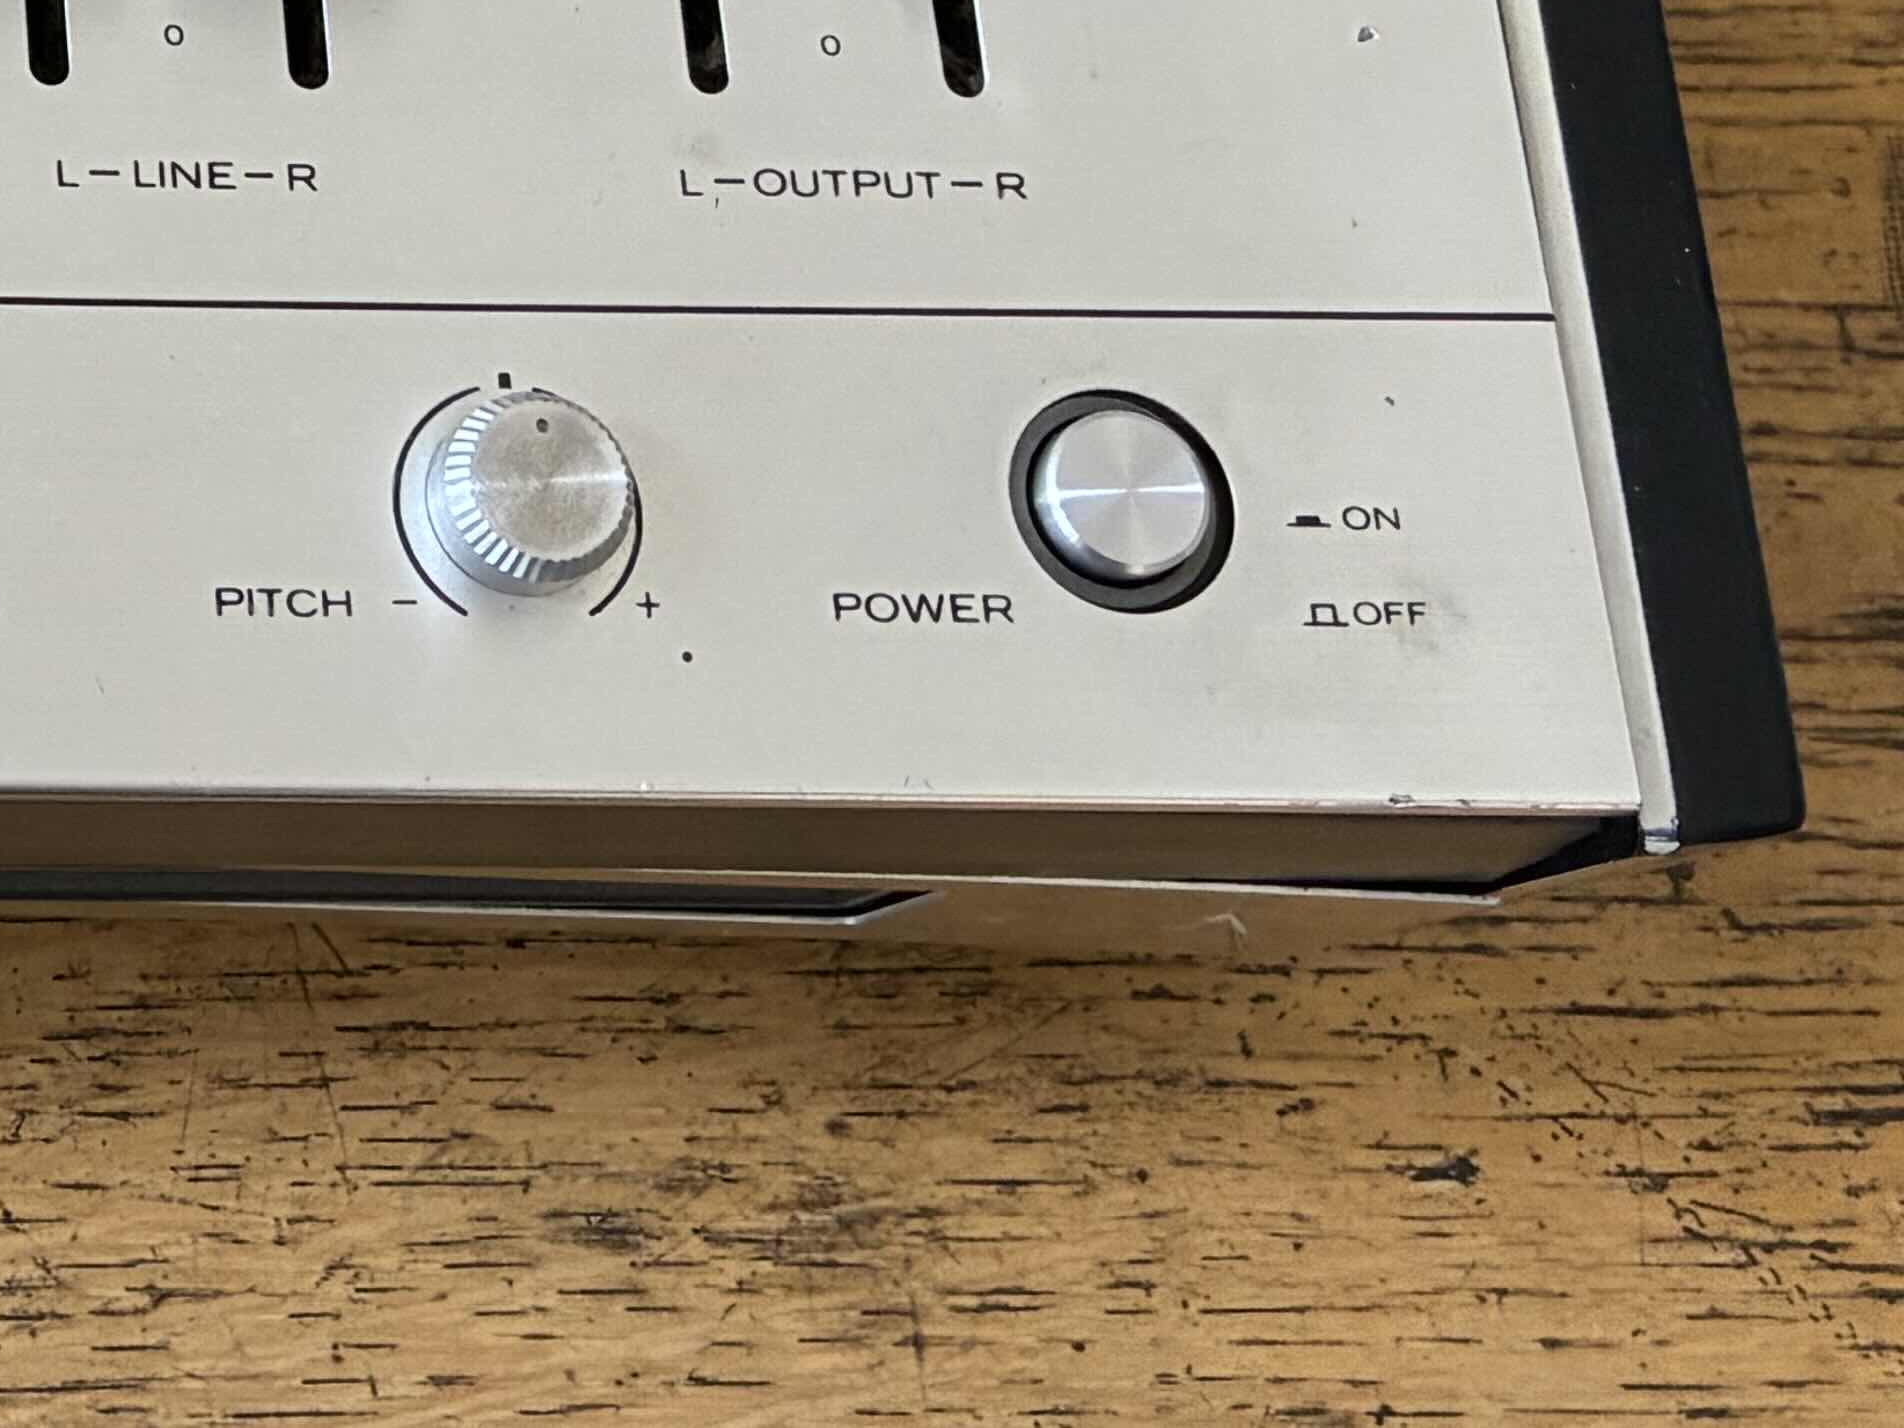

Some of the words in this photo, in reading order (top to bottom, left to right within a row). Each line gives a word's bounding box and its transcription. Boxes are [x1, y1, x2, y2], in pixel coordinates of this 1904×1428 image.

[163, 24, 184, 46] 0
[820, 34, 841, 57] 0
[1342, 505, 1401, 531] ON
[215, 587, 353, 618] PITCH
[832, 592, 1014, 624] POWER
[1353, 601, 1426, 626] OFF
